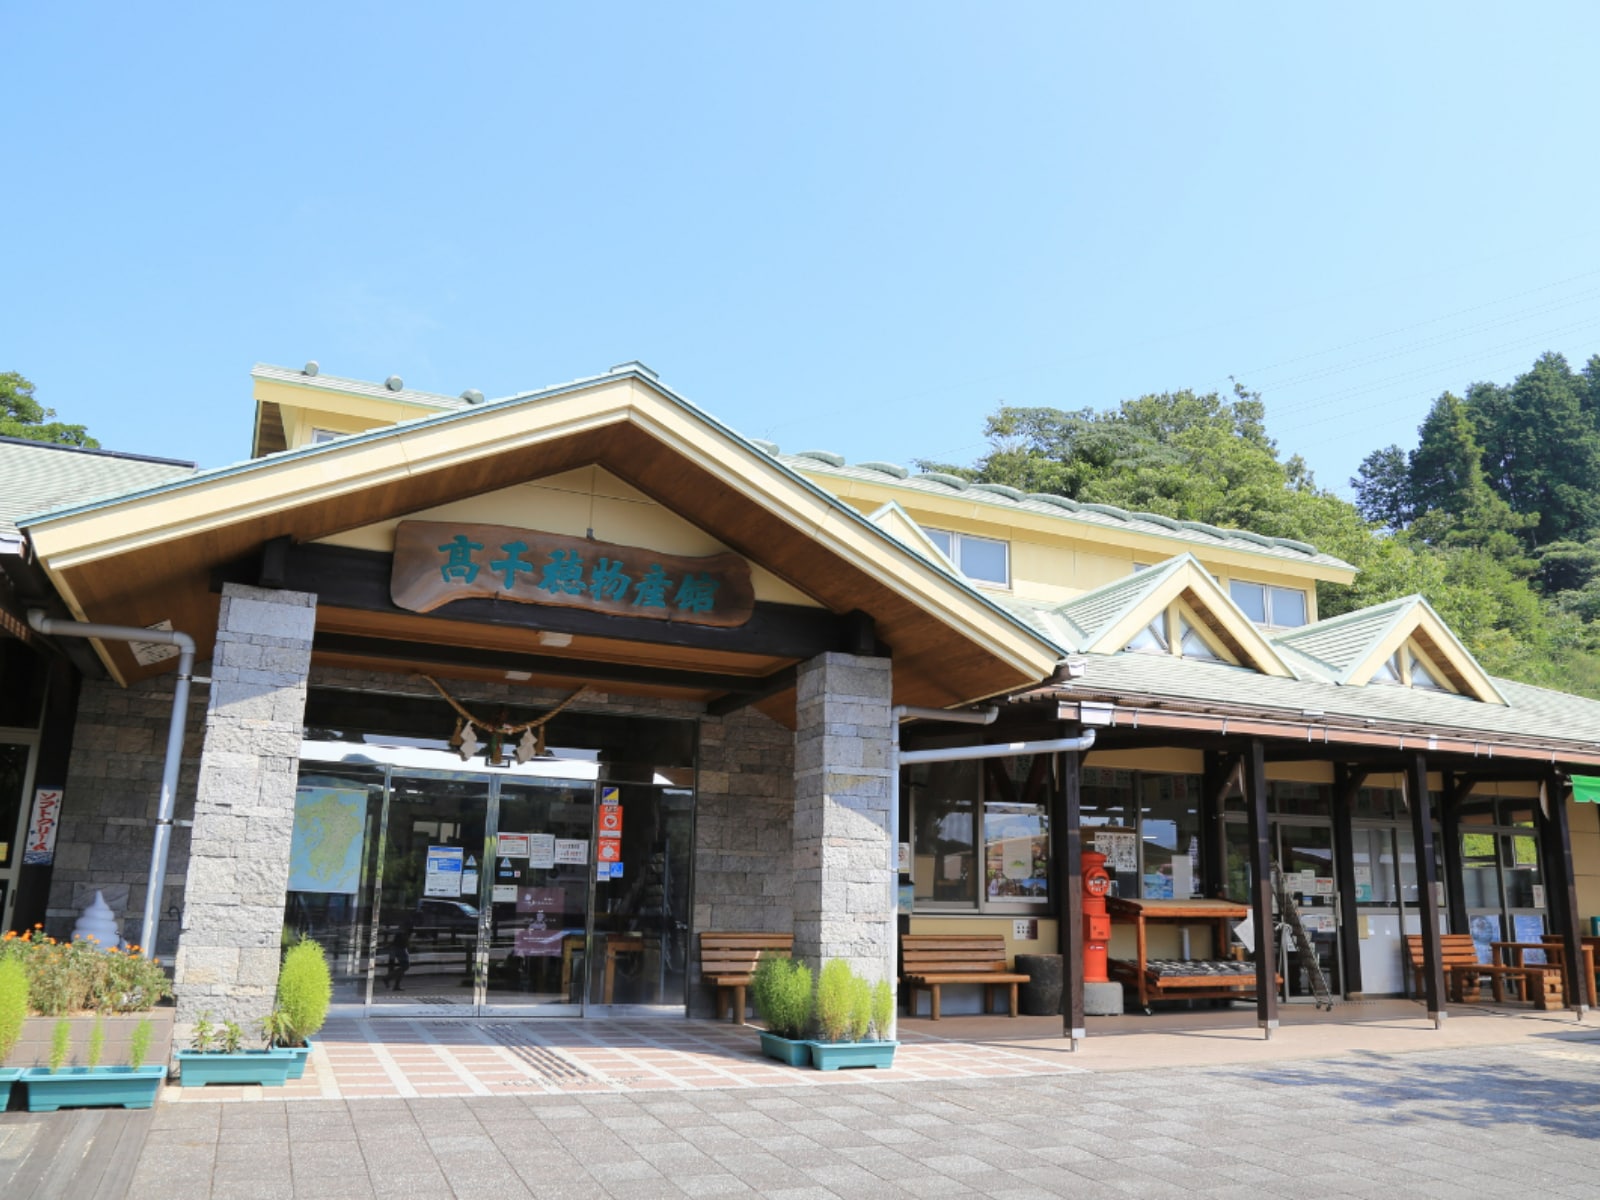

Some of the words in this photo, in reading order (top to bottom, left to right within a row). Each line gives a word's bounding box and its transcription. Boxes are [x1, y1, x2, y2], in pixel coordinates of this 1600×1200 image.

[32, 792, 57, 851] ソフトクリーム
